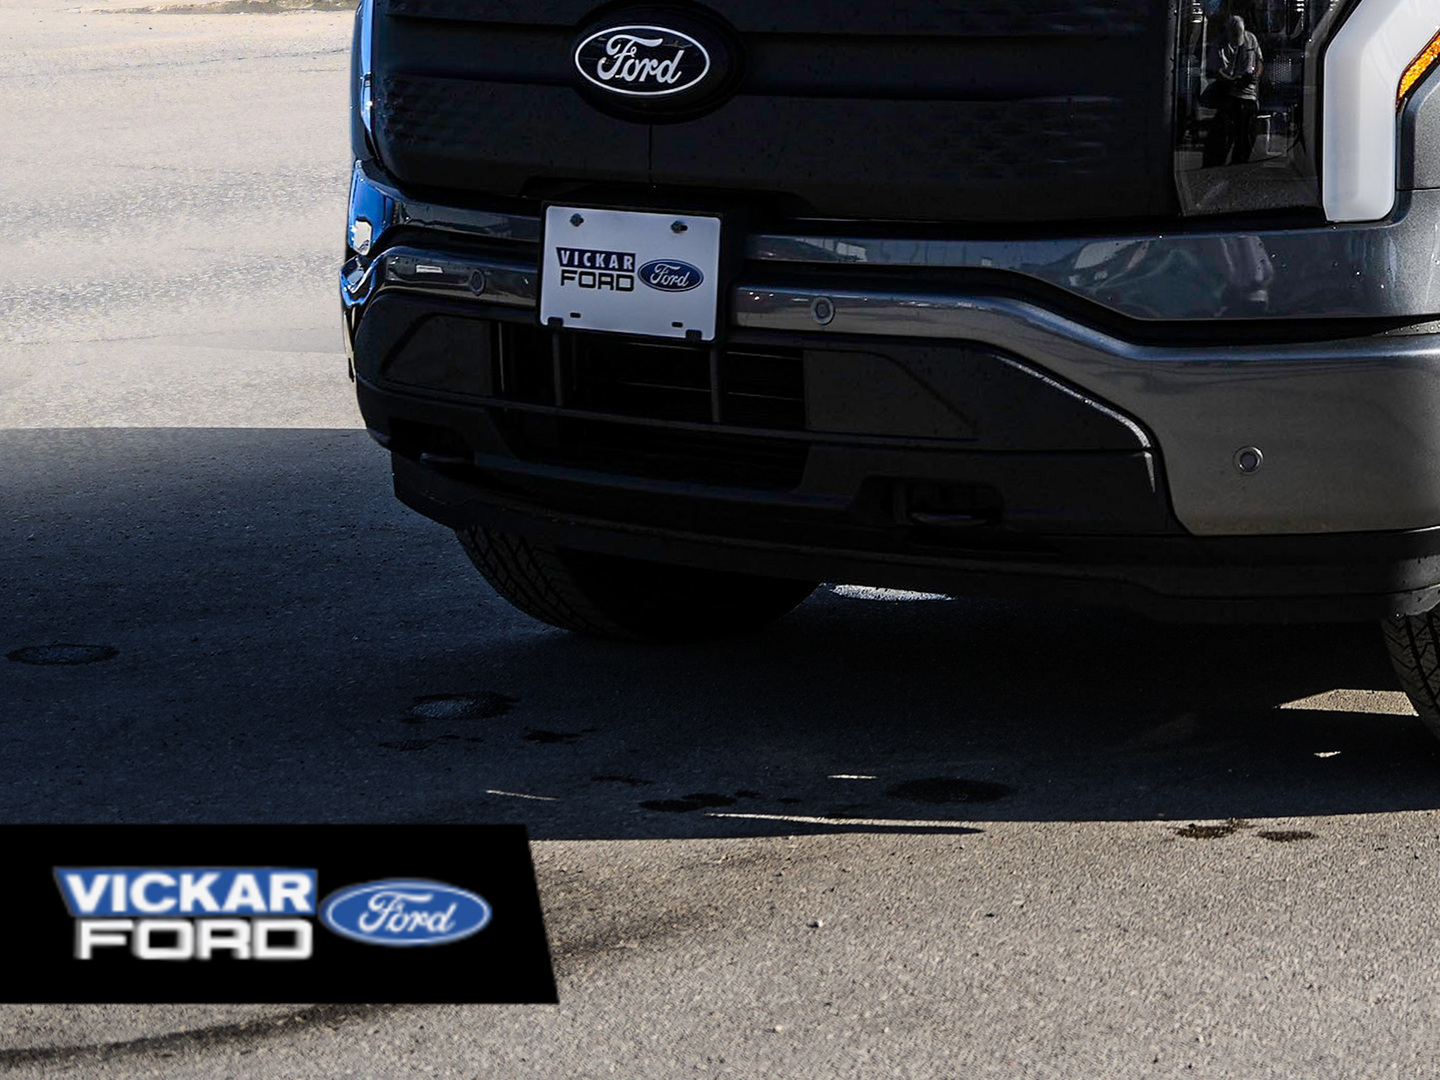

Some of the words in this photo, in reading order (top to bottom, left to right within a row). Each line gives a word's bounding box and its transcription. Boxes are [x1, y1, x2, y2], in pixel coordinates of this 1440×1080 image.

[596, 34, 685, 84] Ford
[560, 250, 634, 271] VICKAR
[560, 269, 635, 292] FORD
[650, 263, 691, 287] Ford
